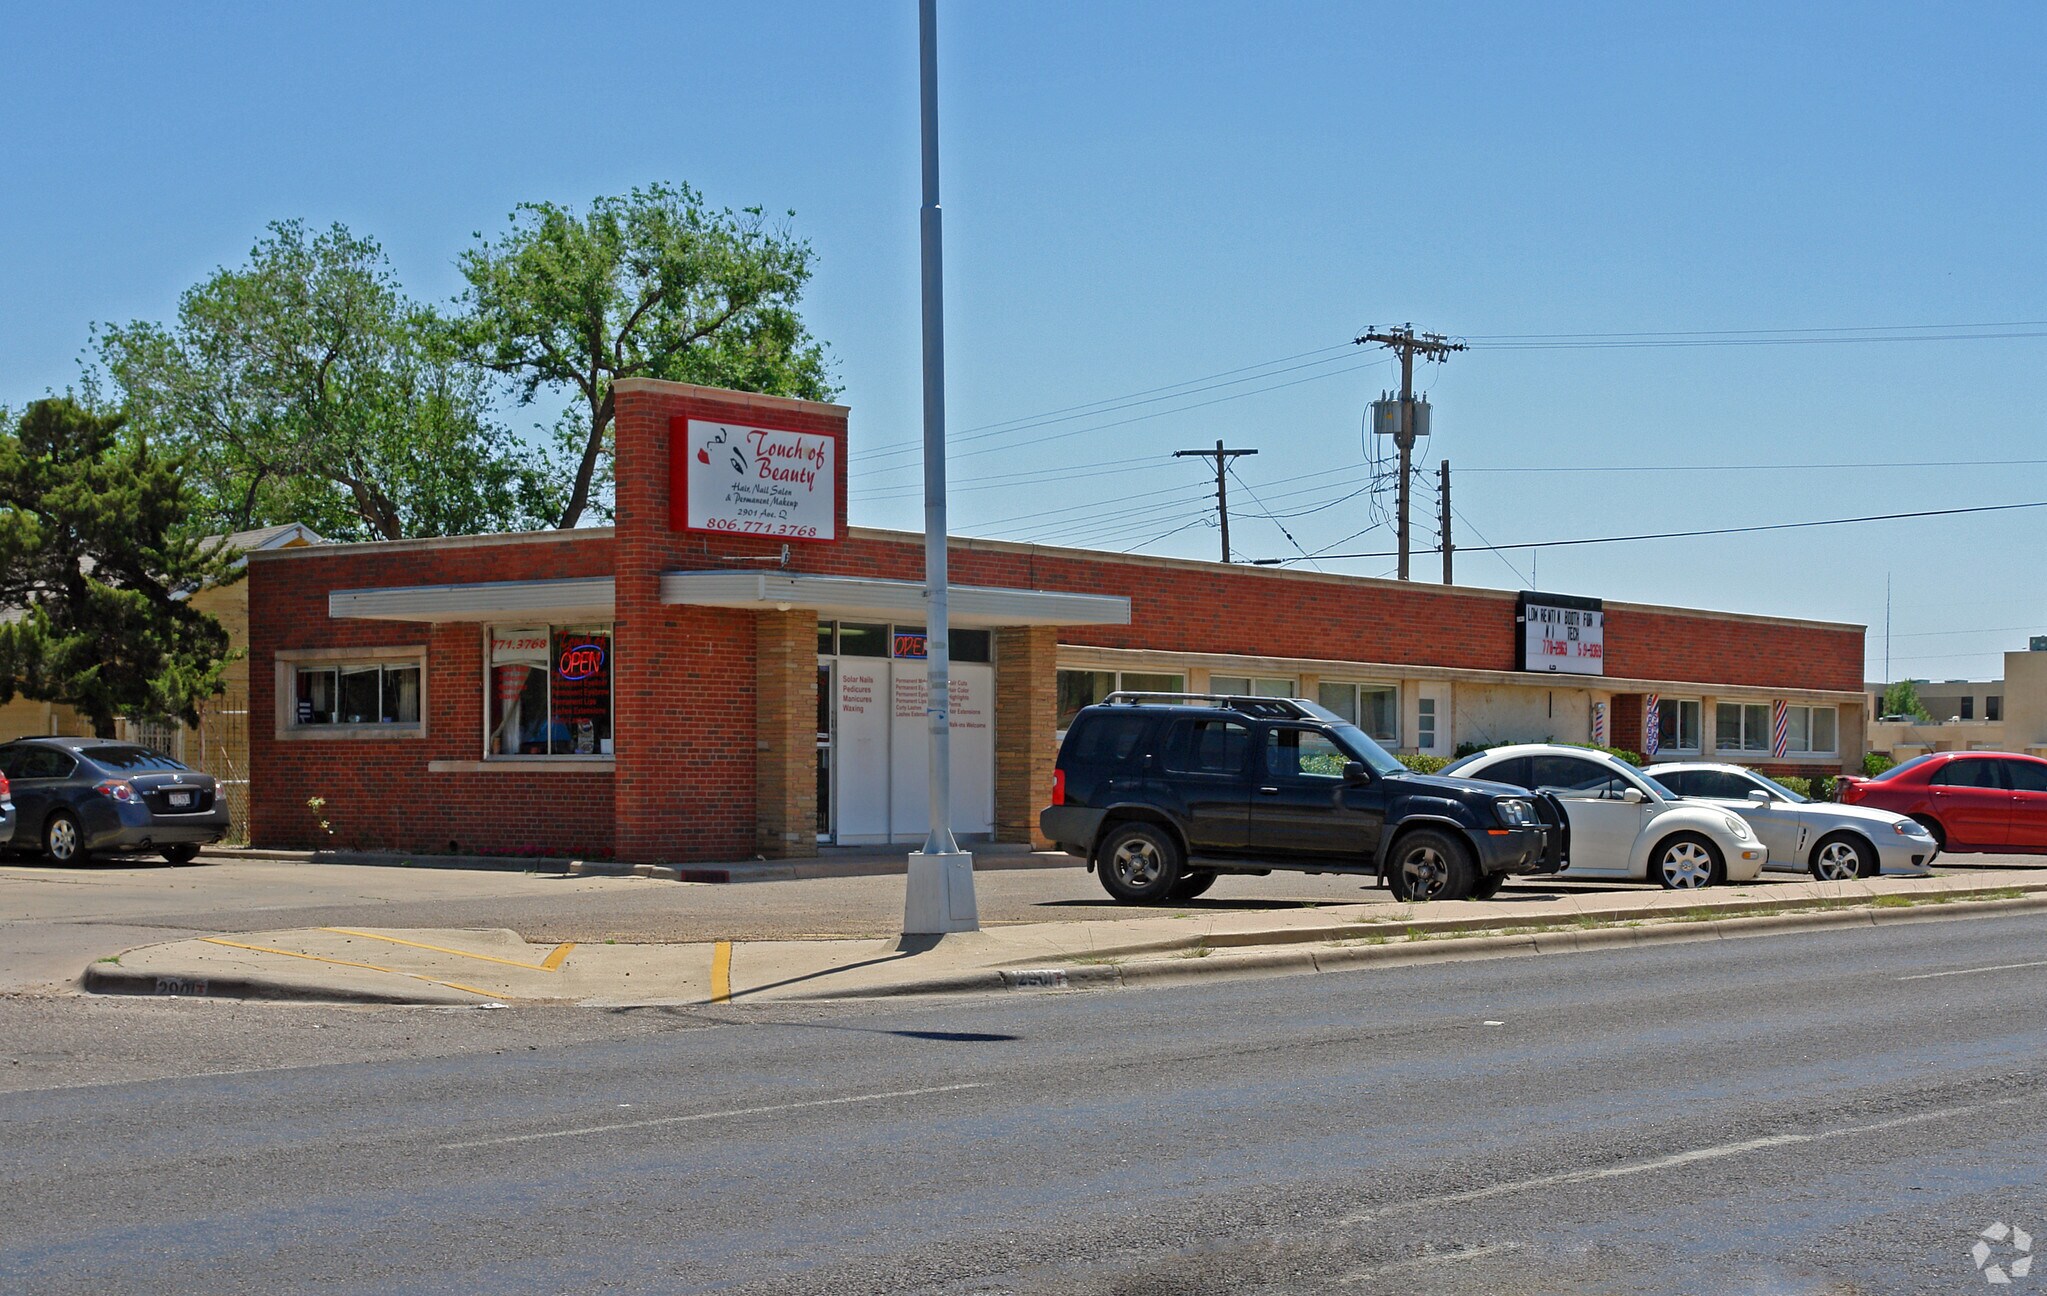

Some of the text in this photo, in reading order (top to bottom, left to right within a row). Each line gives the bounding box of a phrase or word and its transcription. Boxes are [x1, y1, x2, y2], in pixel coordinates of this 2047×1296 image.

[747, 430, 825, 470] Touch of
[755, 457, 815, 492] Beauty
[752, 484, 769, 494] Nail
[770, 485, 792, 496] Salon
[733, 492, 769, 504] Permanent
[769, 497, 798, 510] Makeup
[737, 508, 757, 516] 2901
[779, 510, 787, 519] Q
[706, 518, 817, 537] 806.771.3768
[560, 651, 601, 673] OPEN
[843, 675, 873, 683] Solar Nails
[843, 685, 871, 693] Pedicures
[843, 695, 872, 703] Manicures
[843, 704, 864, 713] Waxing
